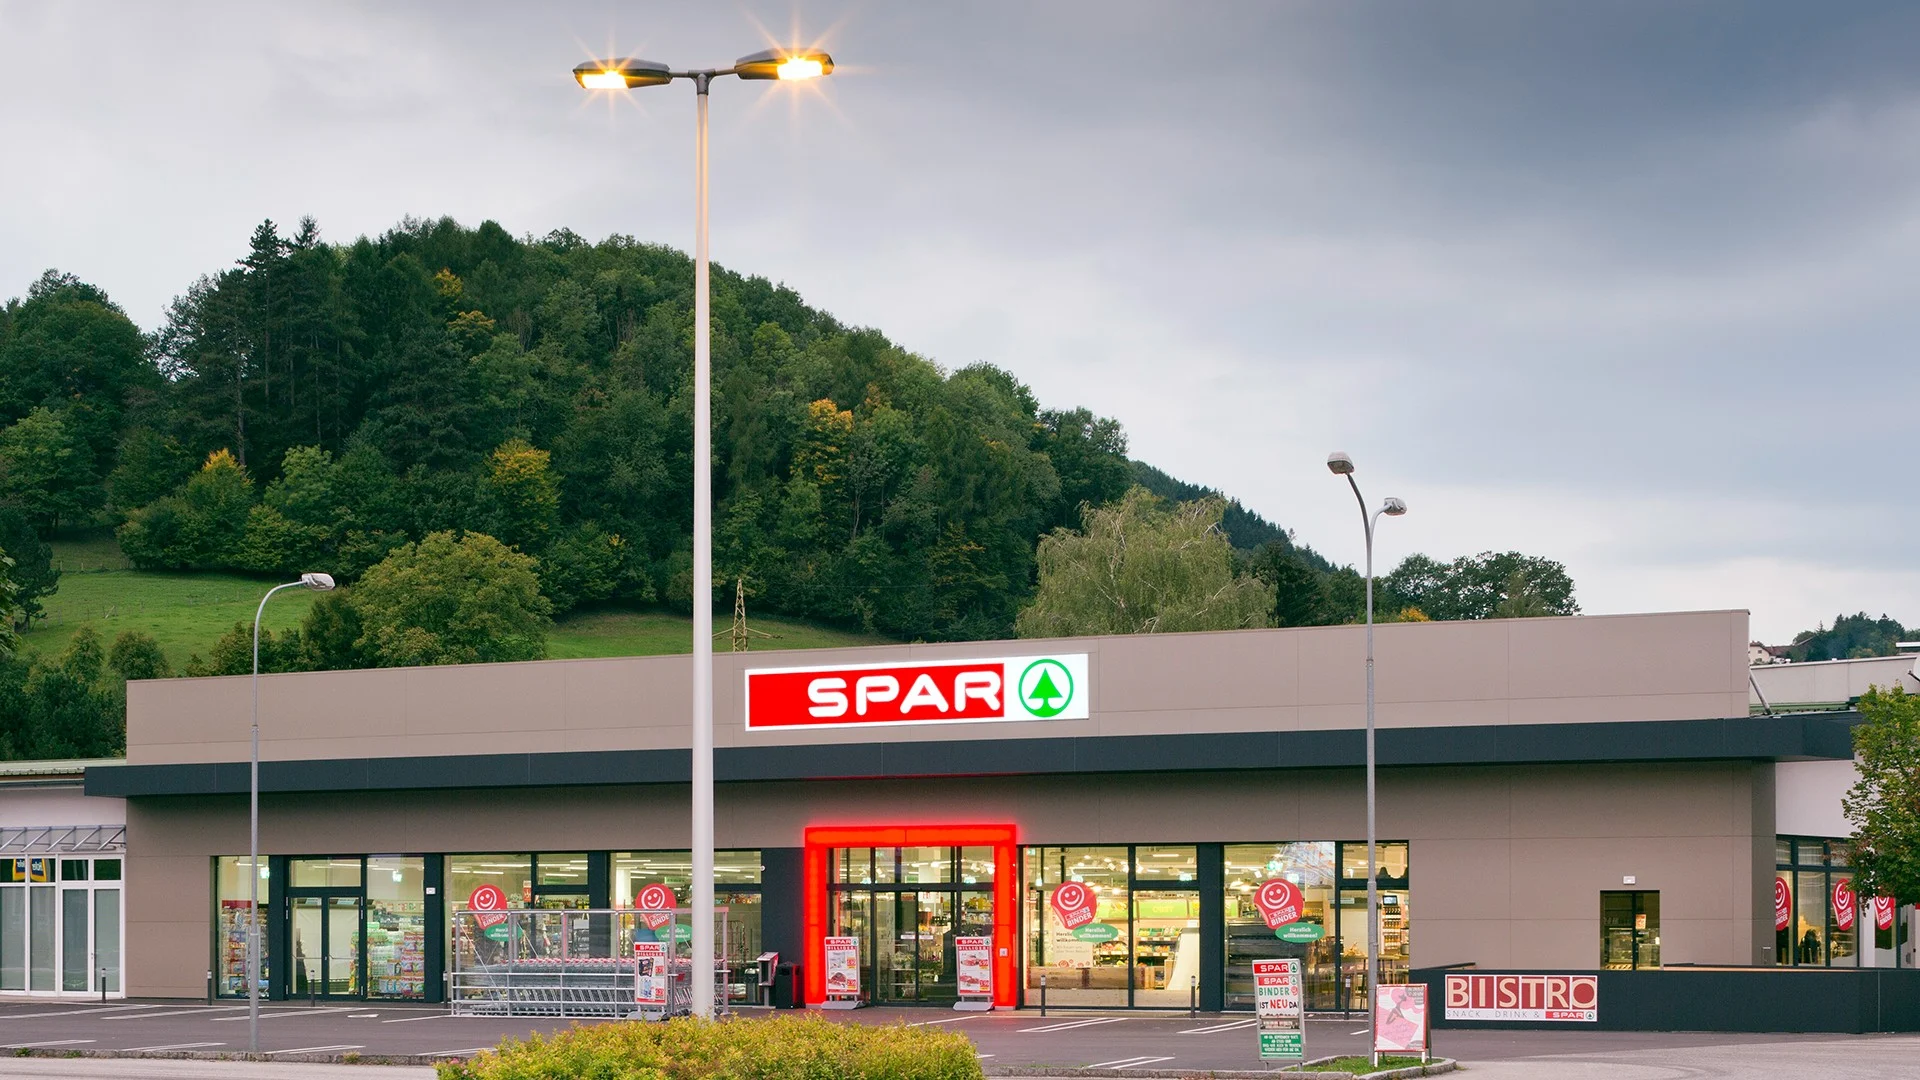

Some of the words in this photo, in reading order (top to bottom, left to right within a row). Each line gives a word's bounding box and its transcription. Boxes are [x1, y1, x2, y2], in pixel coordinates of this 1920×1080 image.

[807, 670, 1001, 718] SPAR
[1066, 911, 1093, 927] BINDER
[1270, 910, 1298, 926] BINDER
[1260, 964, 1289, 972] SPAR
[1263, 977, 1289, 985] SPAR
[1258, 987, 1290, 996] BINDER
[1447, 978, 1597, 1008] BISTRO
[1260, 1001, 1269, 1009] IST
[1269, 999, 1288, 1009] NEU
[1447, 1010, 1481, 1018] SNACK
